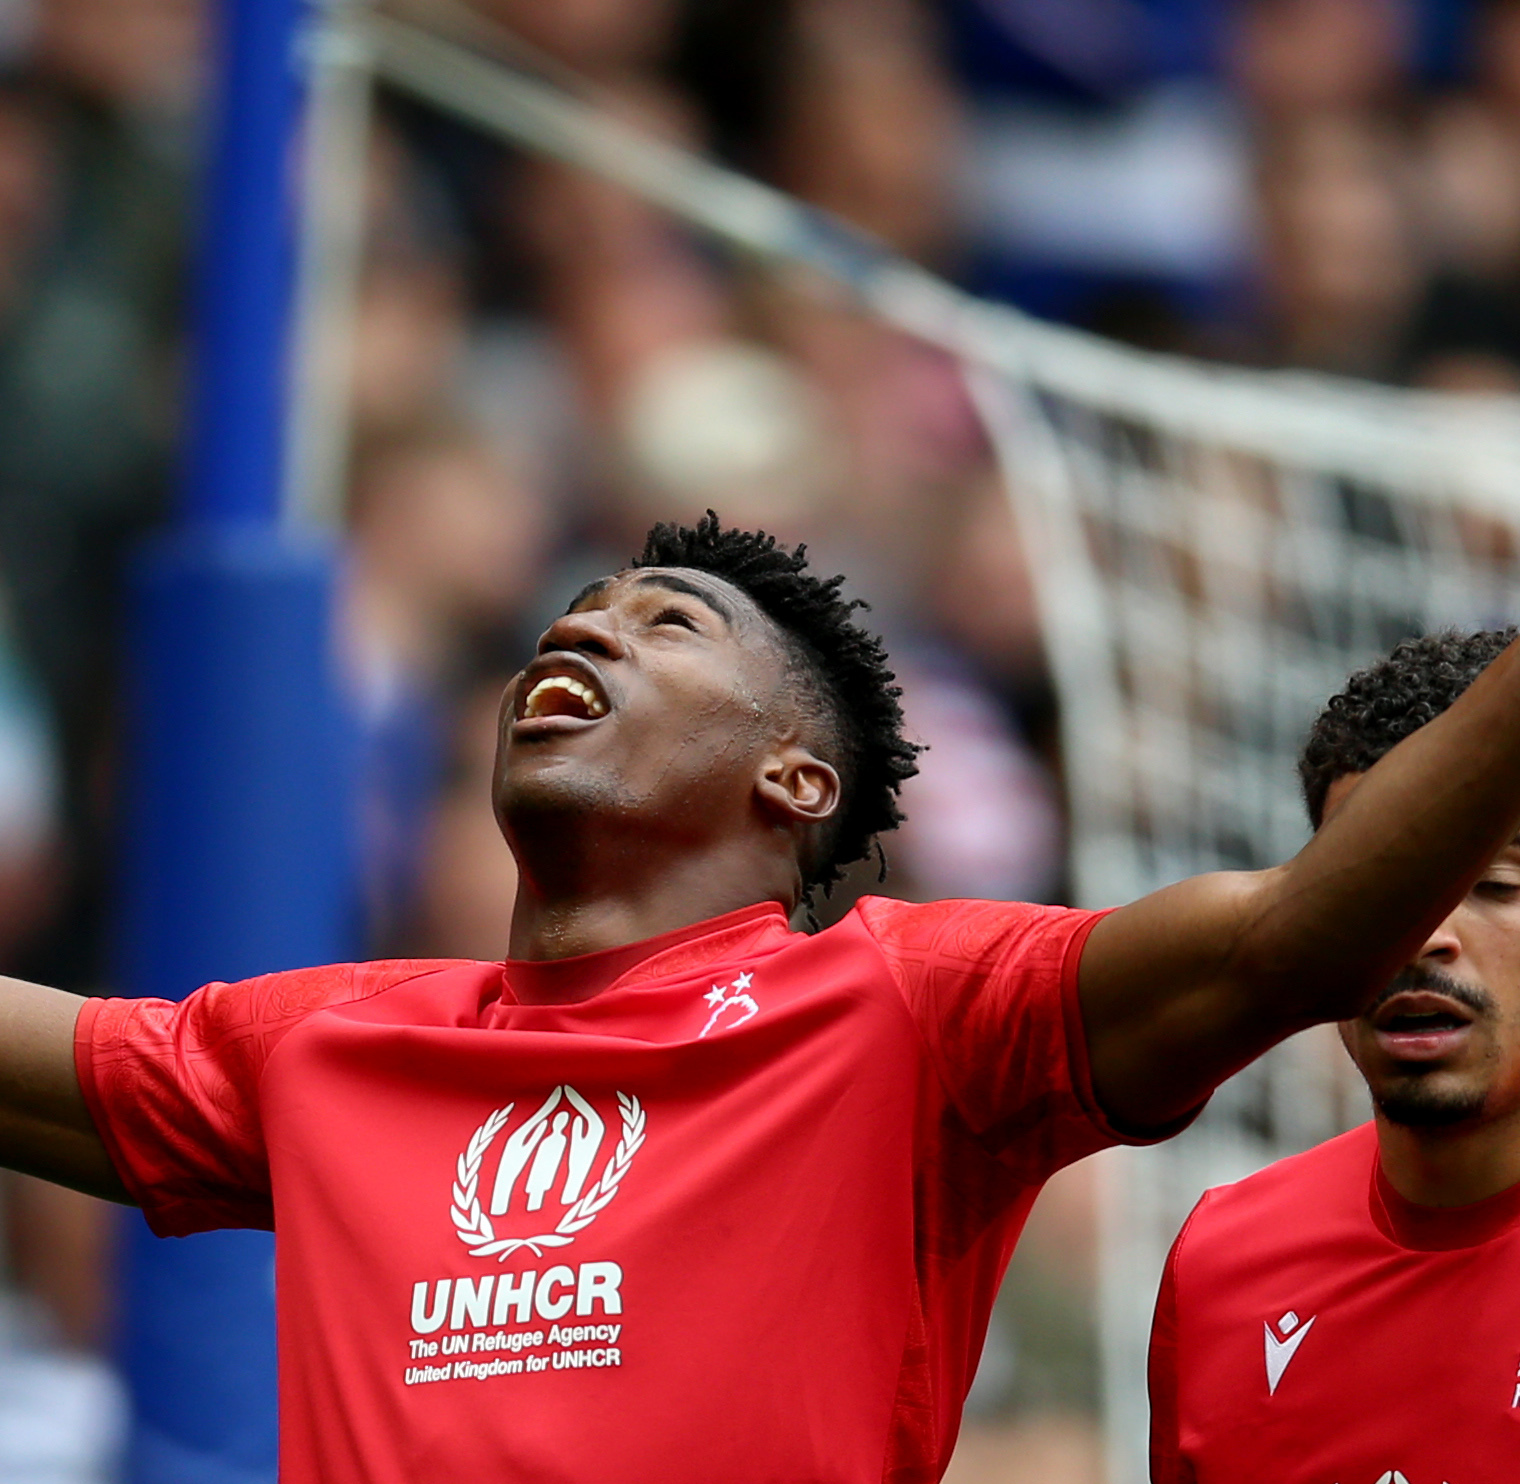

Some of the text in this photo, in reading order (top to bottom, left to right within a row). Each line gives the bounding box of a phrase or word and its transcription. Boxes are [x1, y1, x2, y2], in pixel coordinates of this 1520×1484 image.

[410, 1261, 623, 1334] UNHCR
[409, 1324, 622, 1359] The UN Refugee Agency
[404, 1348, 621, 1385] United Kingdom for UNHCR
